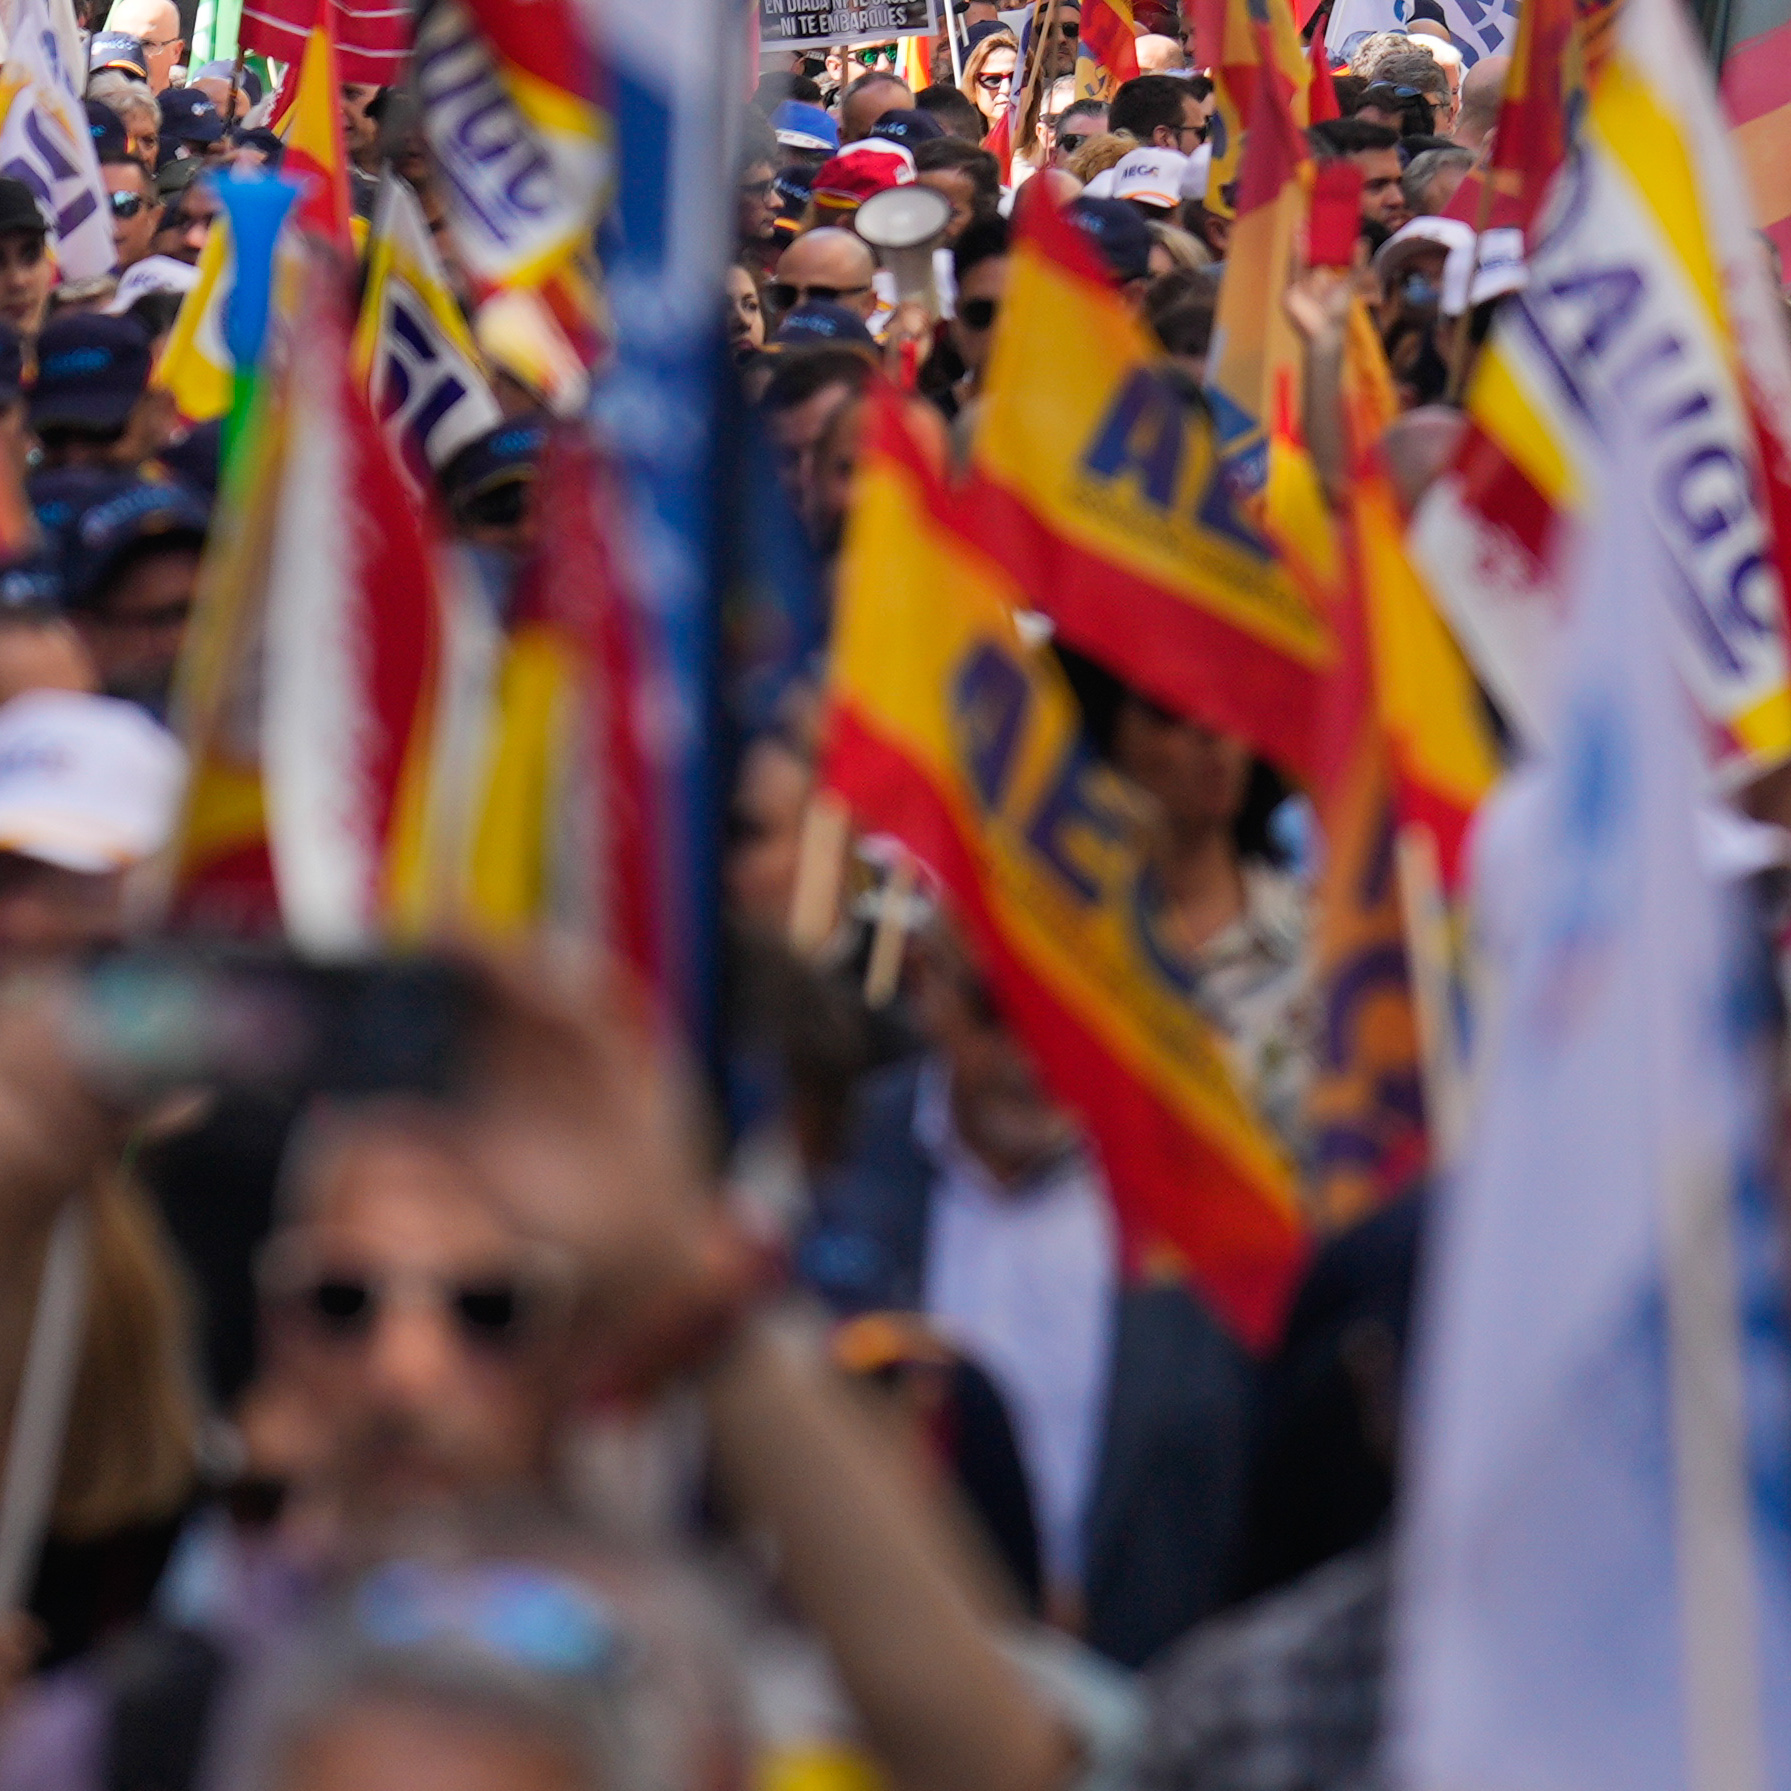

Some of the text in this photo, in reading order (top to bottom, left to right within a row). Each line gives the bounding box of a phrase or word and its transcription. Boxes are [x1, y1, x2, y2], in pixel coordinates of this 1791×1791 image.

[780, 7, 908, 37] NI TE EMBARQUES
